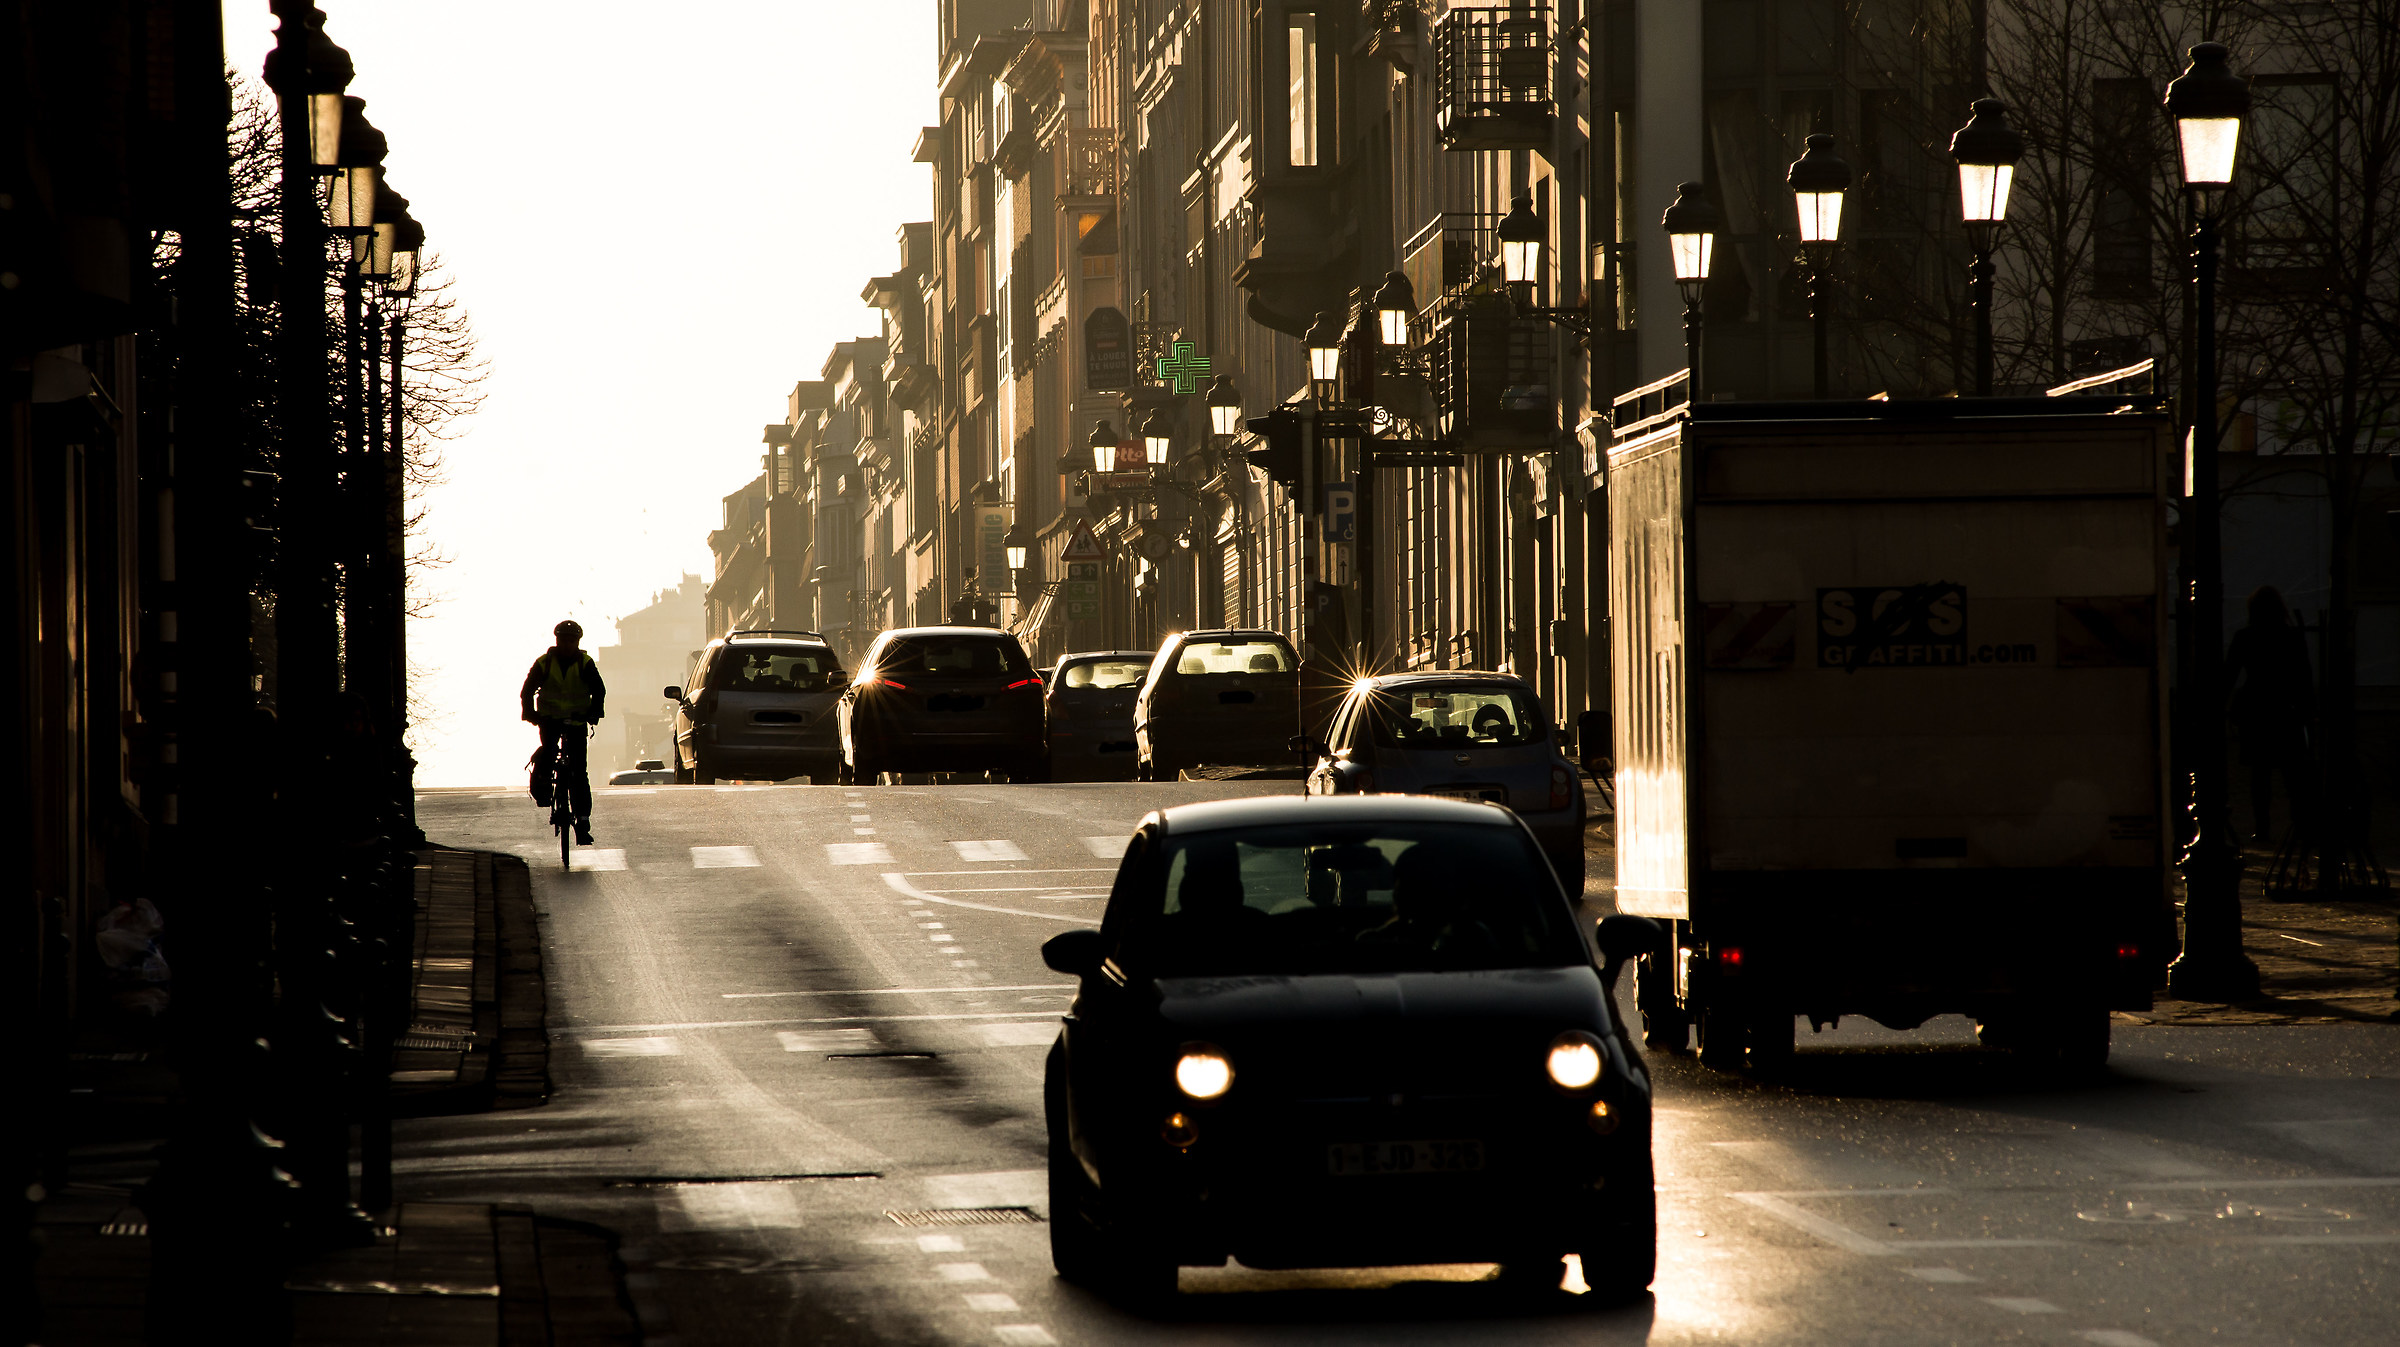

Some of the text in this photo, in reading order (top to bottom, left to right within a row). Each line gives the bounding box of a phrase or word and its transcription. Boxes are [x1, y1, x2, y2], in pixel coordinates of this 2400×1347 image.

[1090, 360, 1127, 371] TE HUUR
[1098, 351, 1127, 362] LOUER
[1328, 490, 1354, 533] P
[980, 513, 1005, 589] energie
[1317, 594, 1330, 613] P
